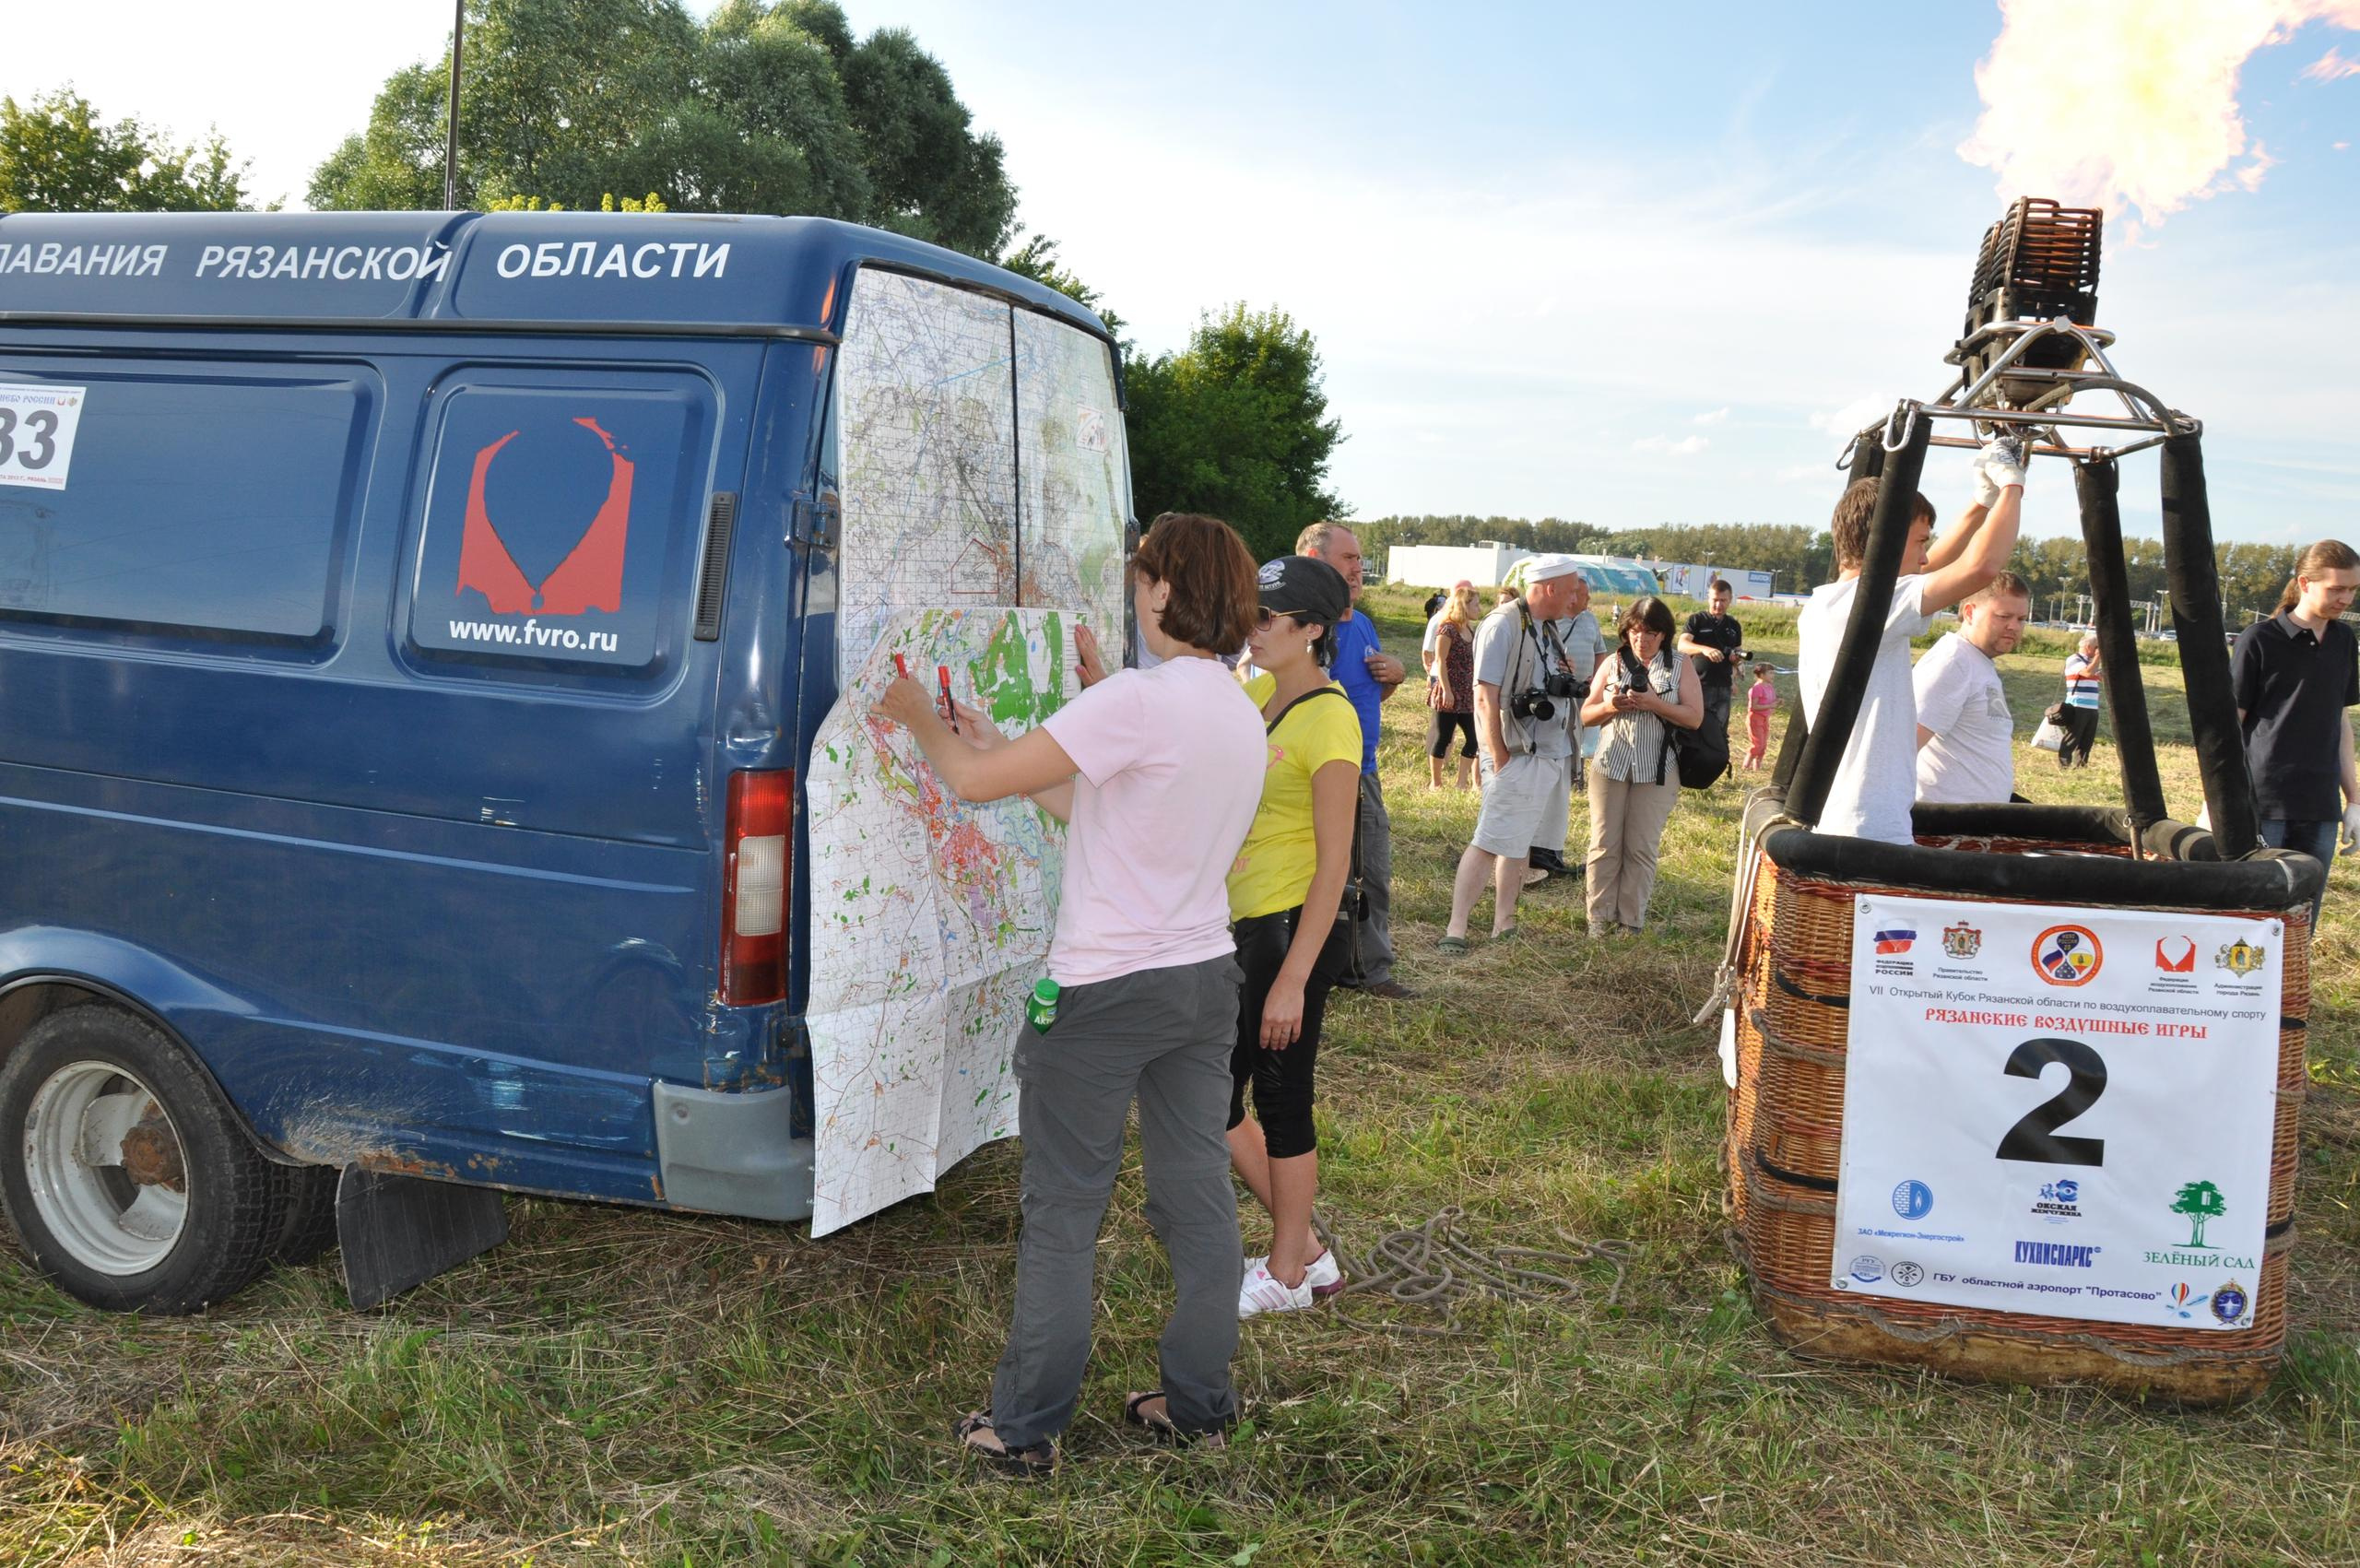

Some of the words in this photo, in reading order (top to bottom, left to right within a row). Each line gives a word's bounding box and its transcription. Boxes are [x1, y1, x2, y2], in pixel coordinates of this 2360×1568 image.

[195, 241, 453, 281] РЯЗАНСКОЙ
[497, 242, 730, 277] ОБЛАСТИ
[449, 619, 618, 652] www.fvro.ru
[1874, 969, 1914, 977] РОССИИ
[1932, 973, 1963, 981] Рязанской
[1938, 966, 1983, 975] Правительство
[1870, 985, 1883, 996] VII
[1889, 986, 1943, 1000] Открытый
[1946, 991, 1976, 1003] Кубок
[1978, 993, 2034, 1006] Рязанской
[2036, 996, 2081, 1008] области
[2083, 1001, 2097, 1010] по
[2100, 1003, 2229, 1020] воздухоплавательному
[2231, 1010, 2267, 1021] спорту
[1924, 1008, 2028, 1028] РЯЗАНСКИЕ
[2035, 1015, 2150, 1036] ВОЗДУШНЫЕ
[2155, 1022, 2209, 1040] ИГРЫ
[1995, 1038, 2108, 1167] 2
[2036, 1202, 2077, 1212] ОКСКАЯ
[1858, 1228, 1873, 1236] ЗАО
[2014, 1240, 2094, 1268] КУХНИСПАРКС
[2142, 1251, 2219, 1267] ЗЕЛЁНЫЙ
[2223, 1256, 2255, 1269] САД
[1933, 1272, 1956, 1283] ГБУ
[1962, 1276, 2024, 1290] областной
[2027, 1282, 2083, 1295] аэропорт
[2085, 1286, 2162, 1302] "Протасово"
